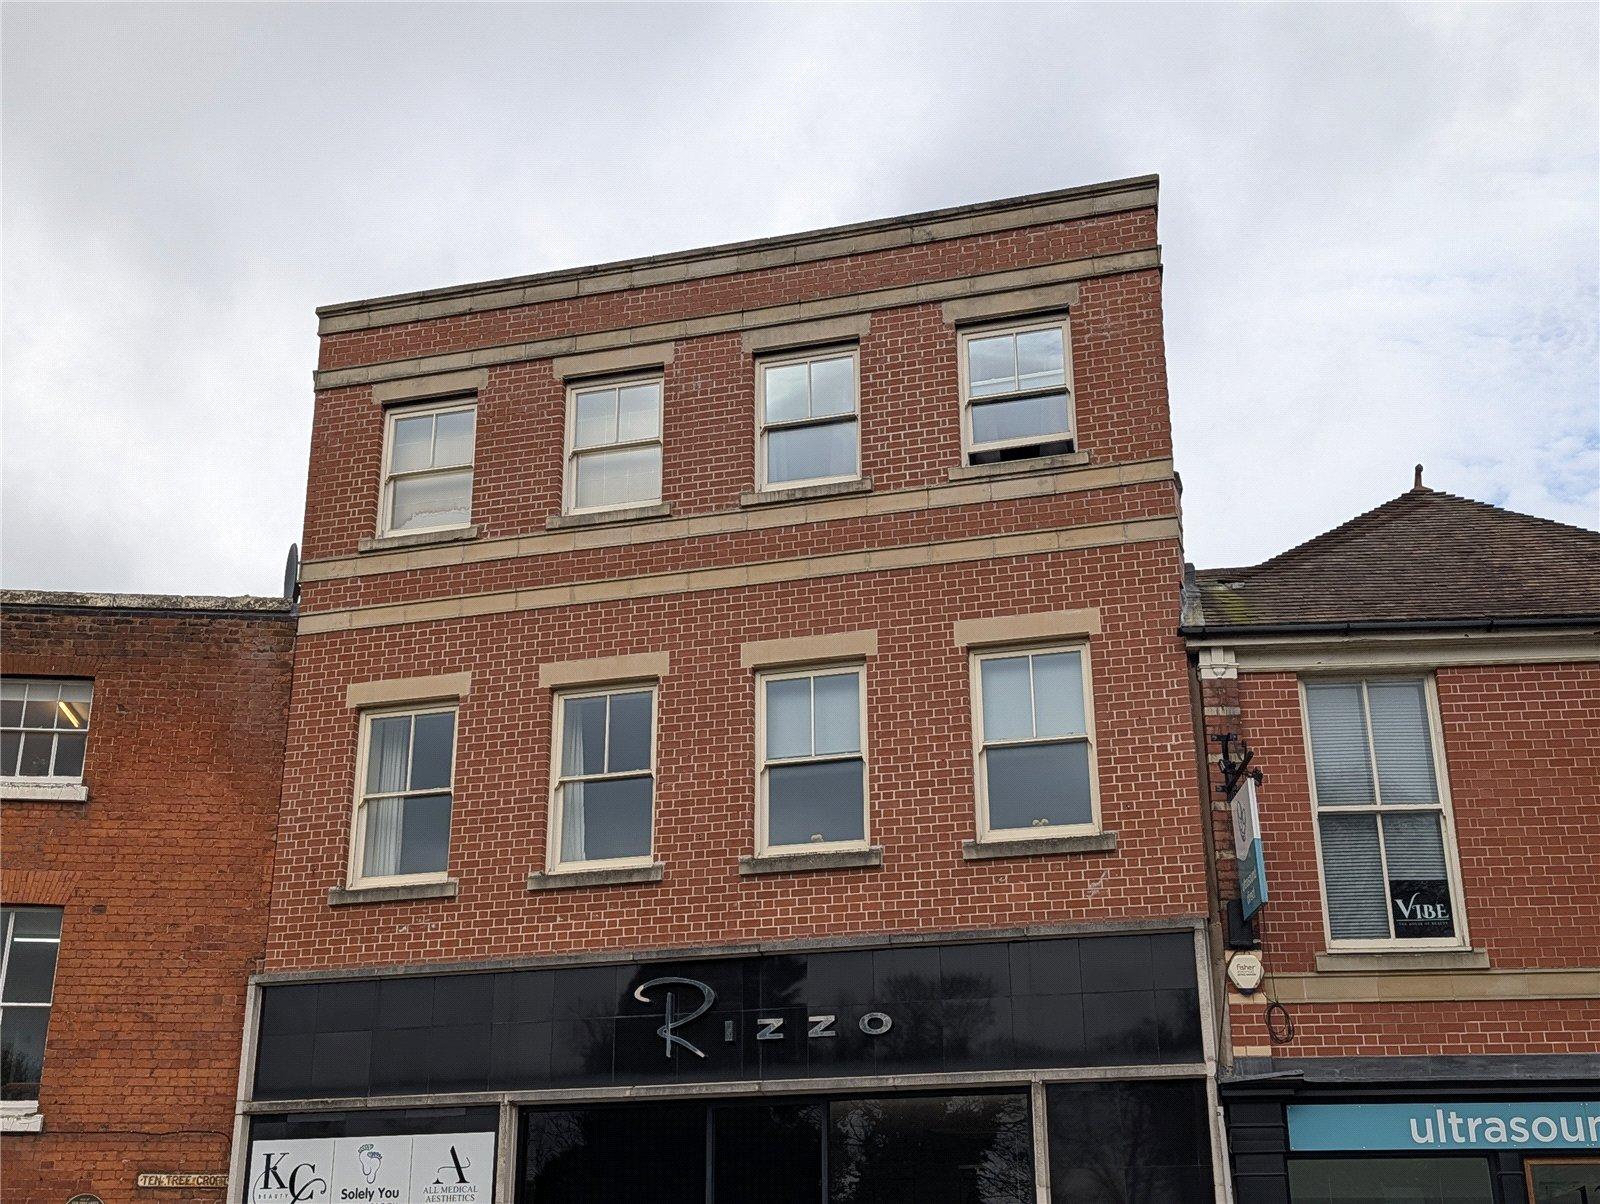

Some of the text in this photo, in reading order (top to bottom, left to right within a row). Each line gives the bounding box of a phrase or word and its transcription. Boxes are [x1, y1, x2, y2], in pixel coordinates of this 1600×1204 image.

[1393, 892, 1450, 919] VIBE
[142, 1175, 161, 1186] TEN
[166, 1175, 192, 1186] TREE
[340, 1187, 400, 1202] Solely You
[422, 1185, 479, 1194] ALL MEDICAL
[425, 1194, 476, 1203] AESTHETICS
